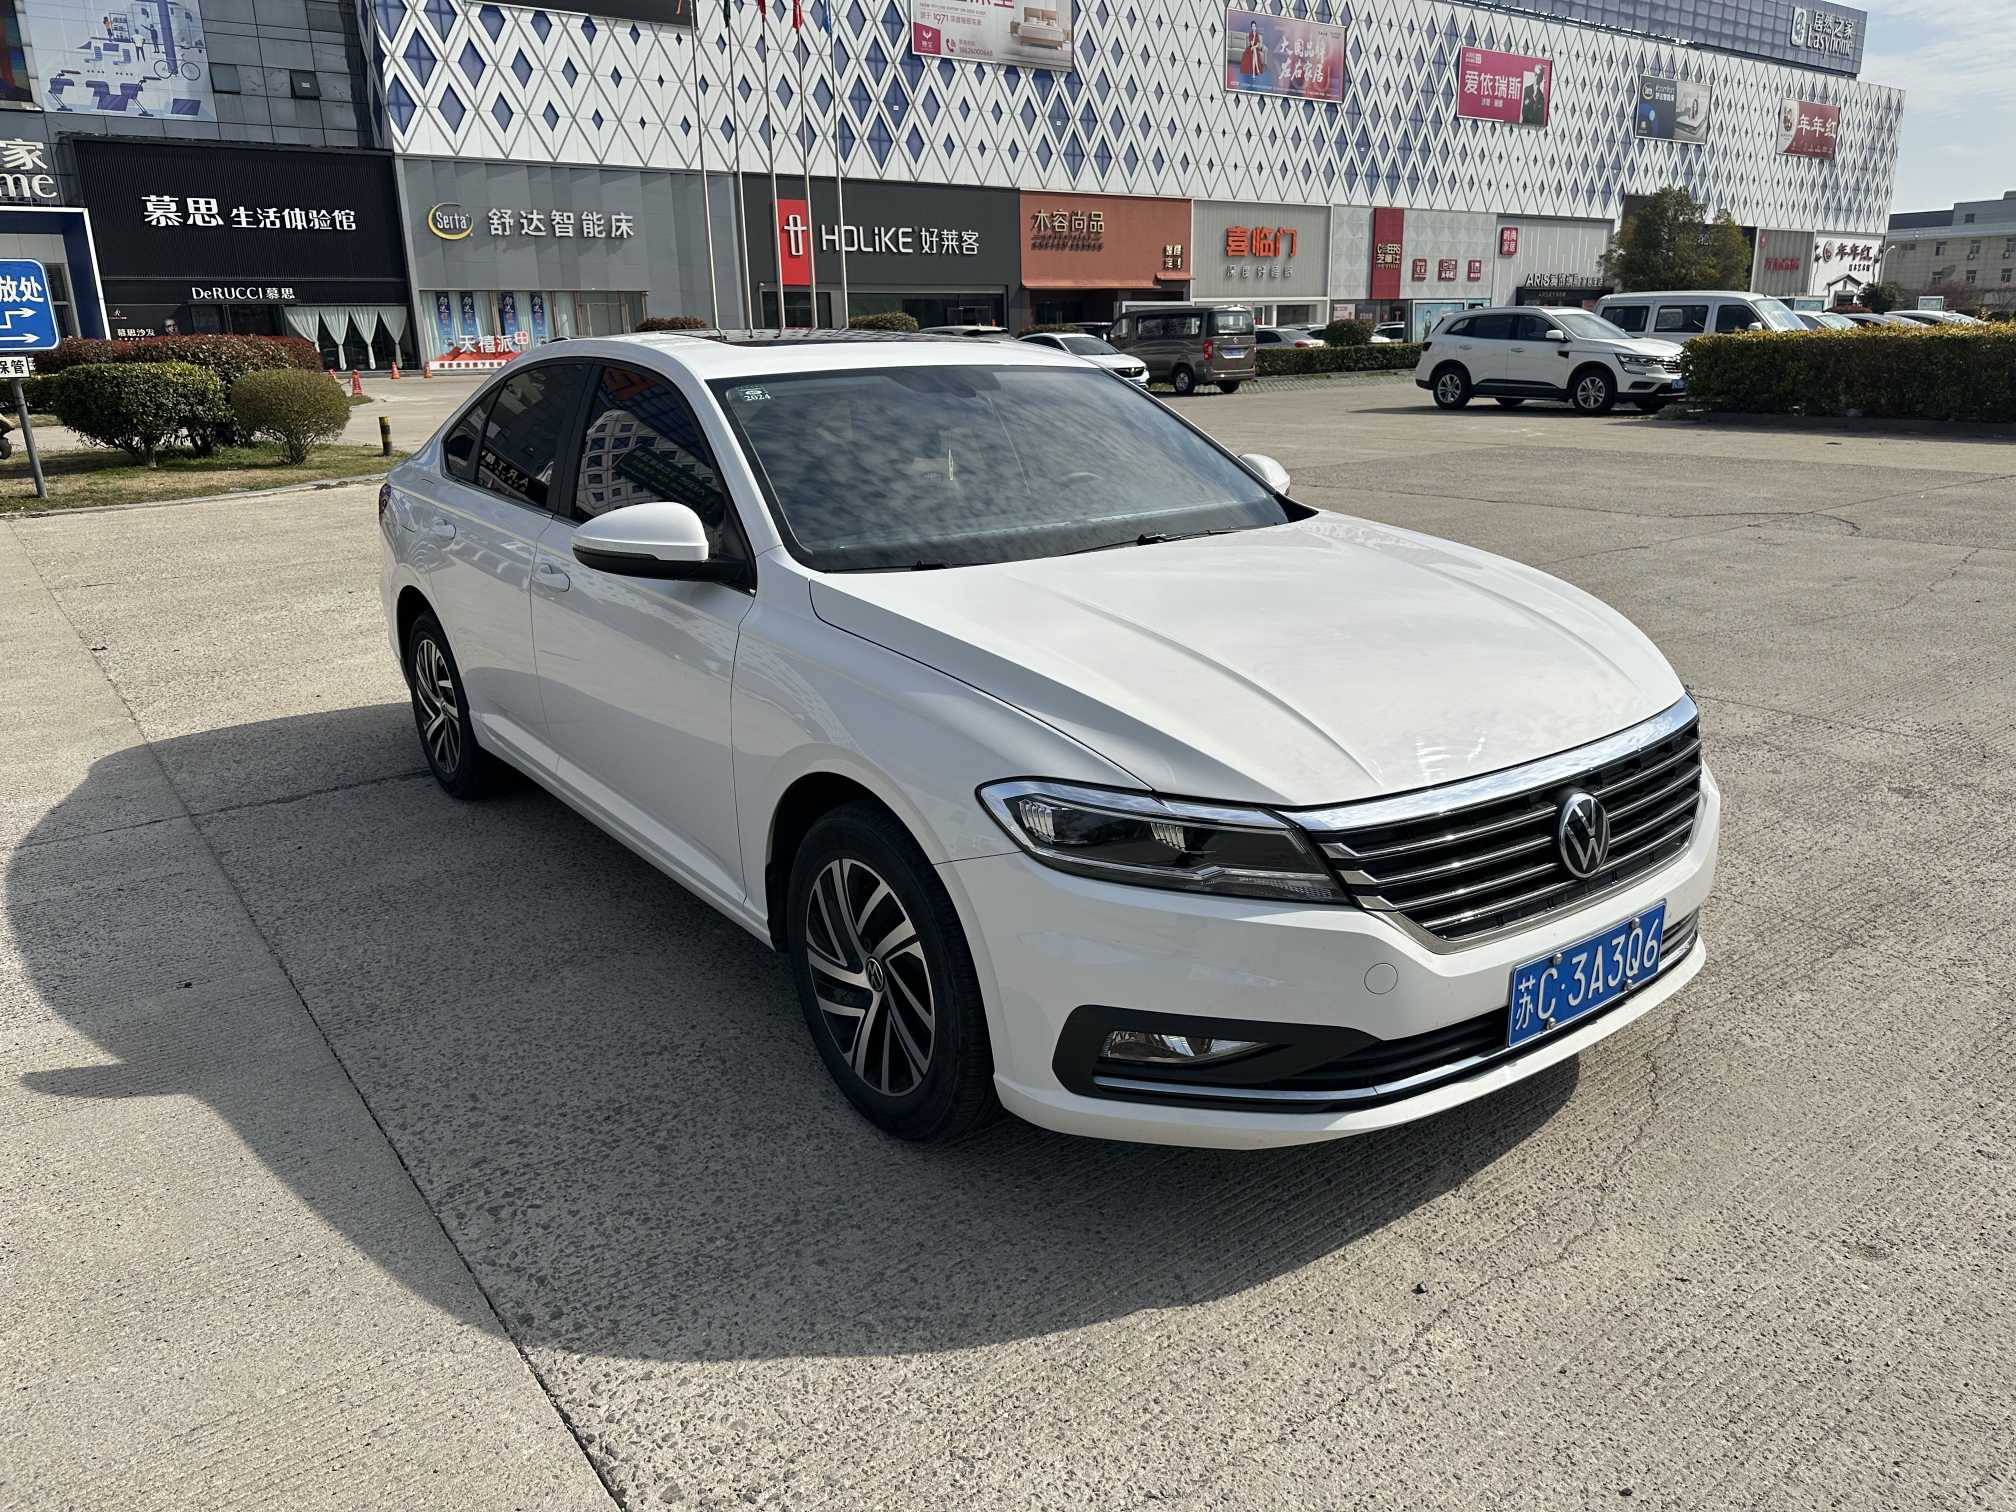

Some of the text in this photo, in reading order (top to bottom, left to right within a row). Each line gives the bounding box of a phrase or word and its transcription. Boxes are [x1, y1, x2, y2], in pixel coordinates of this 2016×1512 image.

[1464, 71, 1521, 99] 爱依瑞斯
[1798, 114, 1837, 138] 年年红
[0, 138, 48, 170] 家
[141, 195, 356, 230] 慕思 生活体验馆
[436, 211, 467, 229] Serta
[488, 208, 635, 239] 舒达智能床
[1034, 209, 1104, 233] 木容尚品
[920, 228, 979, 255] 好莱客
[1226, 226, 1297, 256] 喜临门
[1836, 243, 1873, 260] 年年红
[192, 287, 295, 300] DeRUCCI 慕思
[460, 335, 515, 353] 天禧派
